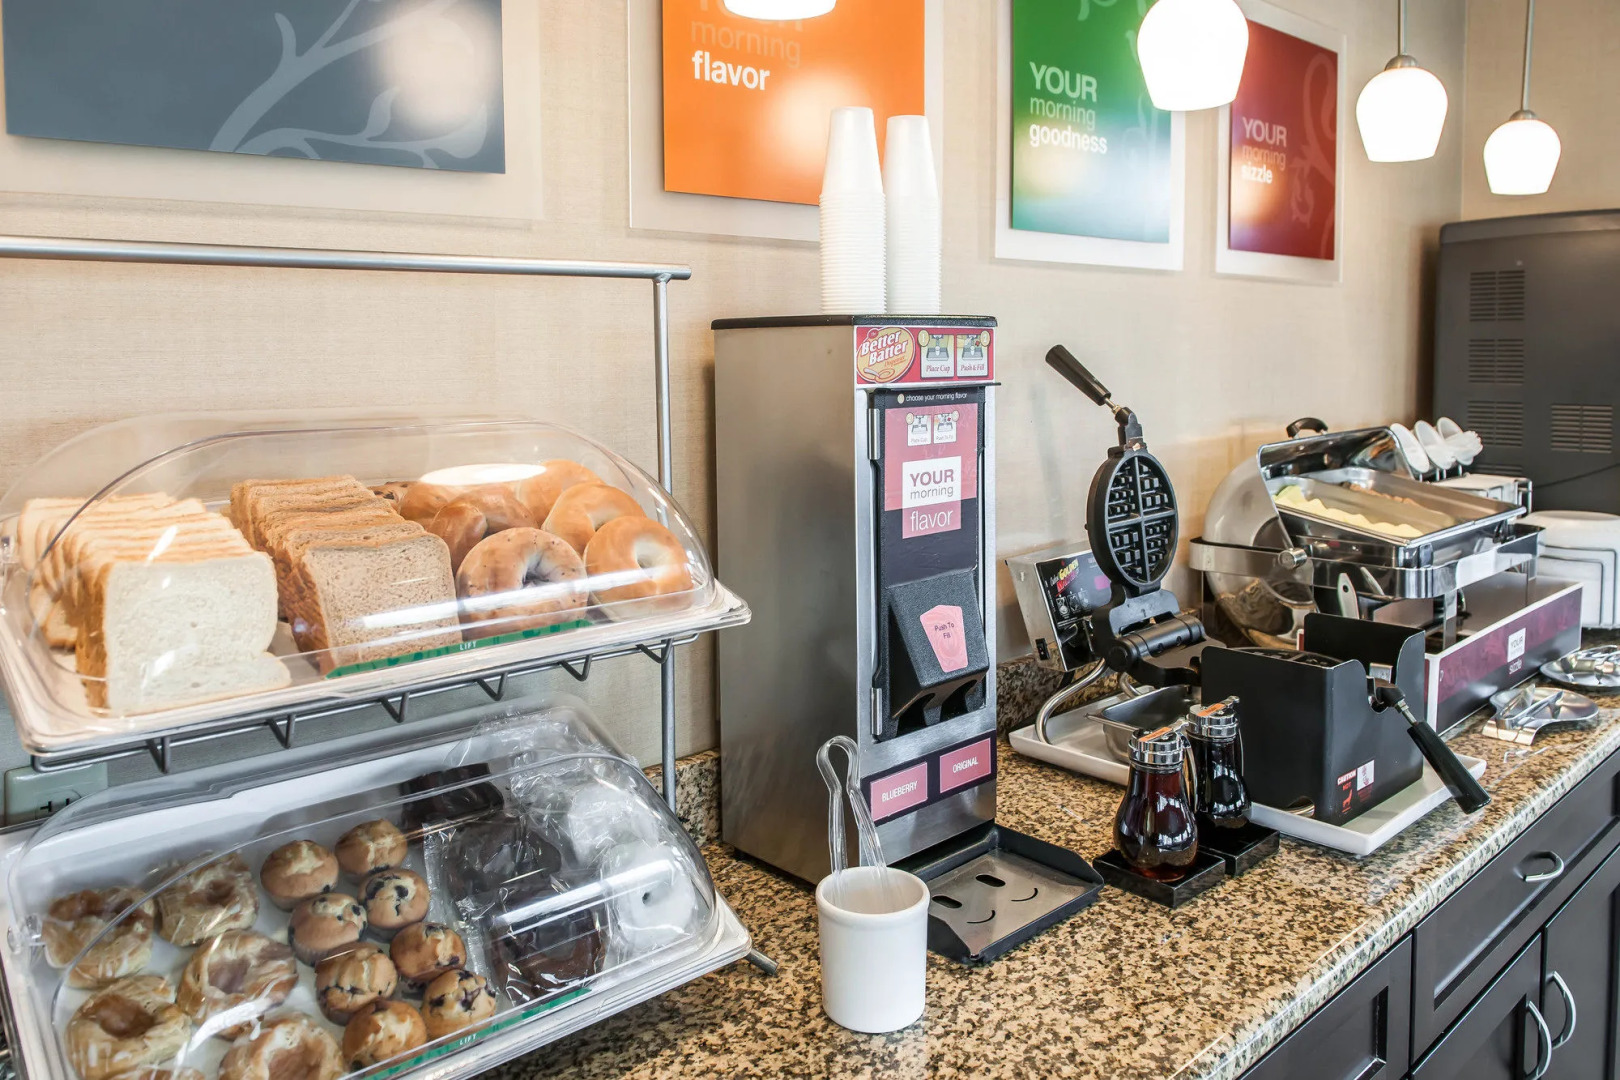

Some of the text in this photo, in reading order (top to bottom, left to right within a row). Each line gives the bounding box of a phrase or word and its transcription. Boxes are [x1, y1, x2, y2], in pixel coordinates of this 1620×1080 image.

[691, 20, 801, 69] morning
[692, 50, 770, 91] flavor
[1029, 61, 1098, 103] YOUR
[1030, 97, 1096, 131] morning
[1029, 123, 1108, 155] goodness
[1242, 116, 1288, 148] YOUR
[1242, 145, 1287, 172] morning
[861, 331, 902, 357] Better
[868, 340, 909, 367] Batter
[906, 391, 968, 402] choose your morning flavor
[909, 468, 955, 487] YOUR
[910, 486, 954, 500] morning
[910, 510, 954, 532] flavor
[934, 624, 947, 632] Push
[459, 640, 477, 650] LIFT
[952, 756, 979, 773] ORIGINAL
[881, 780, 918, 803] BLUEBERRY
[459, 1033, 477, 1046] LIFT
